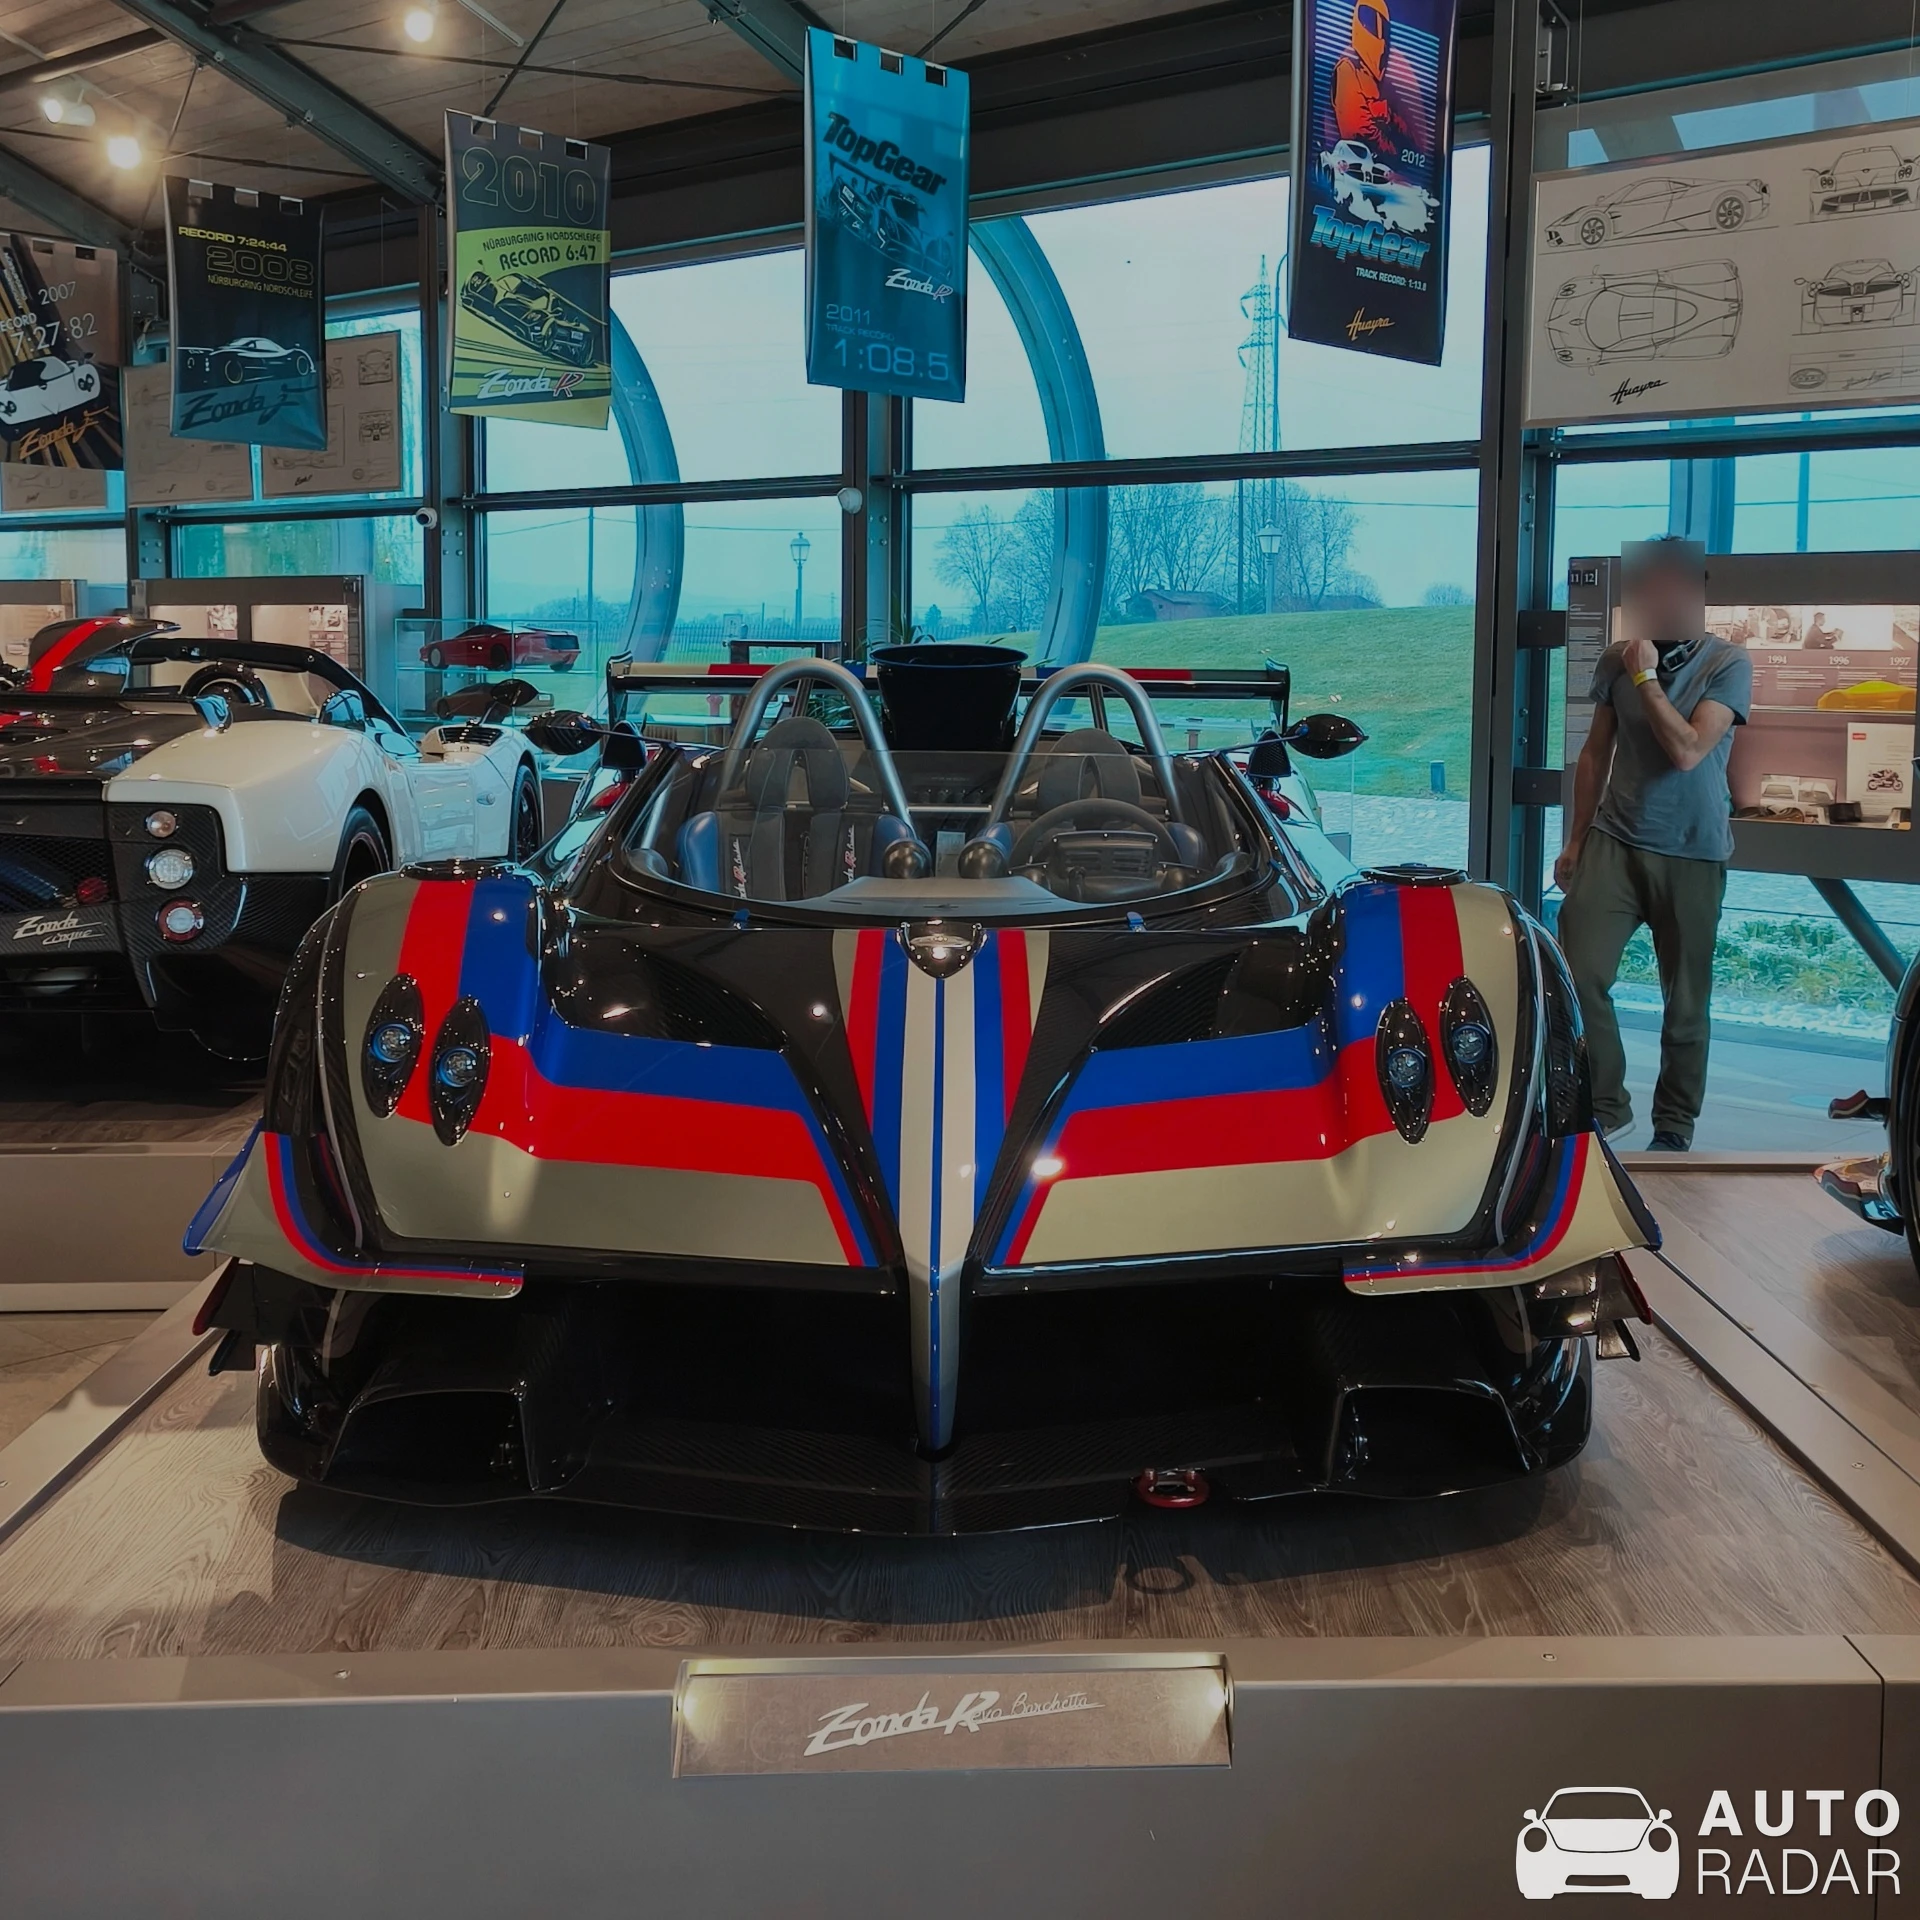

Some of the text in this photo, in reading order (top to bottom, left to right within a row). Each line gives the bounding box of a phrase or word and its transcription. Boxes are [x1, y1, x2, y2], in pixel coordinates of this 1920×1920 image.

[823, 111, 947, 196] TopGear
[1401, 149, 1426, 168] 2012
[462, 146, 597, 226] 2010
[178, 226, 288, 252] RECORD 7:24:44
[483, 231, 601, 252] NÜRBURGRING NORDSCHLEIFE
[1310, 204, 1431, 269] TopGear
[206, 245, 314, 286] 2008
[499, 244, 596, 271] RECORD 6:47
[263, 283, 313, 298] NORDSCHLEIFE
[884, 268, 953, 304] Zonda R
[1356, 267, 1378, 280] TRACK
[1378, 272, 1407, 287] RECORD:
[37, 281, 77, 306] 2007
[0, 312, 37, 333] ECORD
[826, 303, 870, 325] 2011
[10, 312, 98, 357] 7:27:82
[825, 322, 895, 342] TRACK RECORD
[834, 338, 949, 381] 1:08.5
[477, 367, 585, 399] Zonda R
[1610, 378, 1669, 405] Huayra
[180, 385, 265, 431] Zonda
[19, 415, 76, 460] Zonda
[1570, 573, 1595, 583] 11 12
[1767, 655, 1787, 665] 1994
[1828, 656, 1850, 666] 1996
[1889, 656, 1911, 667] 1997
[12, 911, 103, 940] Zonda
[803, 1690, 942, 1756] Zonda
[1008, 1691, 1105, 1717] Barchetta
